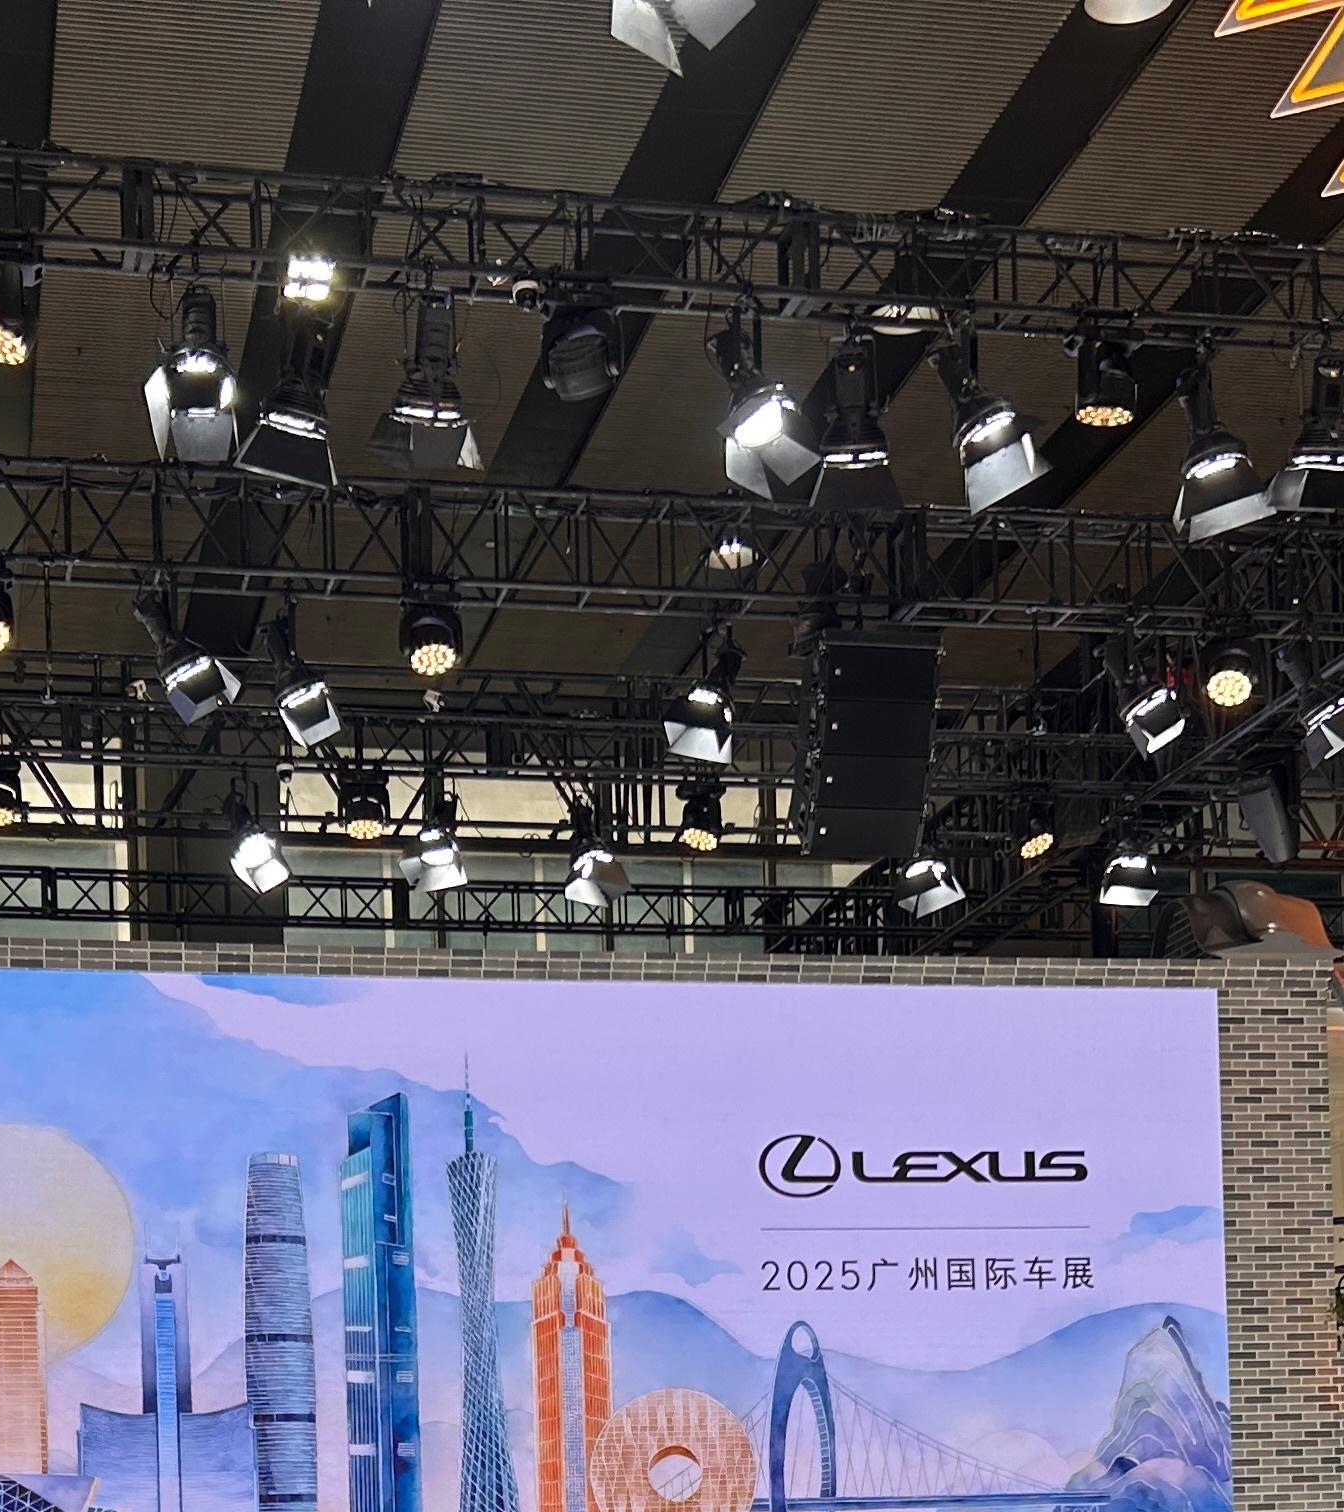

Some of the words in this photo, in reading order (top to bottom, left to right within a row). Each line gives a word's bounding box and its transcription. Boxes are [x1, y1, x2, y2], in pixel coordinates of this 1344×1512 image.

[851, 1150, 1089, 1183] LEXUS
[760, 1256, 1095, 1292] 2025广州国际车展
